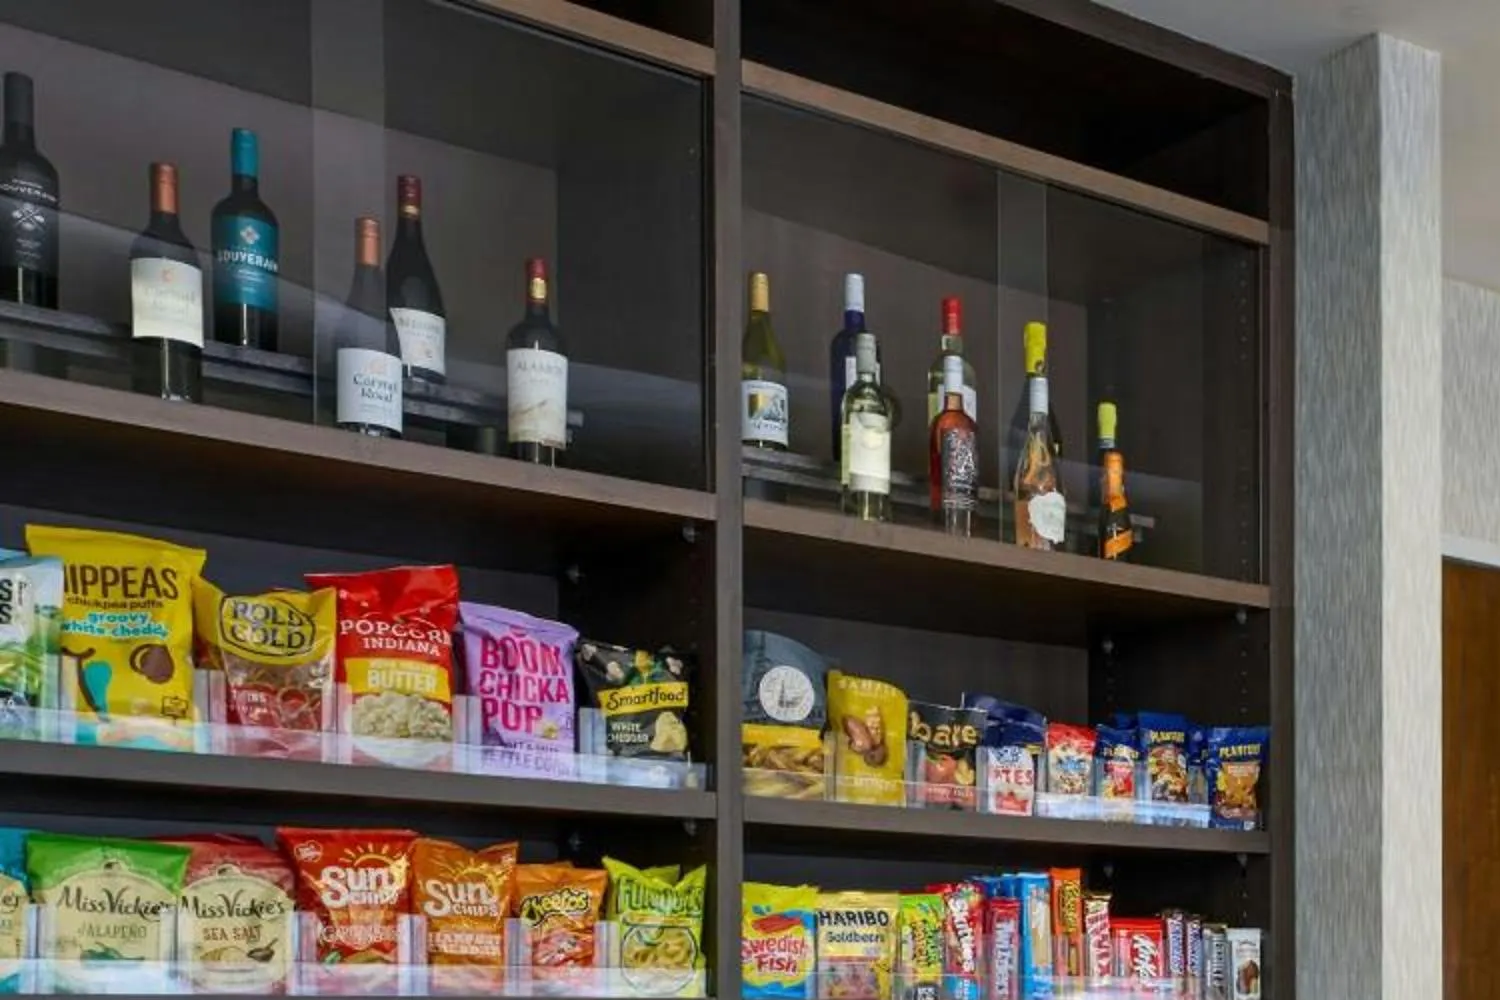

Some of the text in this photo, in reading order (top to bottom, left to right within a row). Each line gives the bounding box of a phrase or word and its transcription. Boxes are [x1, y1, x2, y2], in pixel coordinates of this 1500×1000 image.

[231, 599, 309, 627] ROLD
[230, 625, 306, 649] GOLD
[340, 618, 452, 647] POPCORN
[363, 637, 441, 657] INDIANA
[479, 636, 567, 677] BOOM
[367, 668, 437, 693] BUTTER
[479, 670, 570, 705] CHICKA
[605, 687, 686, 712] Smartfood
[480, 698, 543, 735] POP
[909, 711, 978, 747] bare
[320, 865, 395, 908] Sun
[424, 879, 492, 917] Sun
[57, 886, 103, 914] Miss
[181, 895, 224, 919] Miss
[818, 909, 890, 927] HARIBO
[203, 925, 263, 942] SEA SALT
[741, 933, 809, 958] Swedish
[756, 956, 798, 974] Fish
